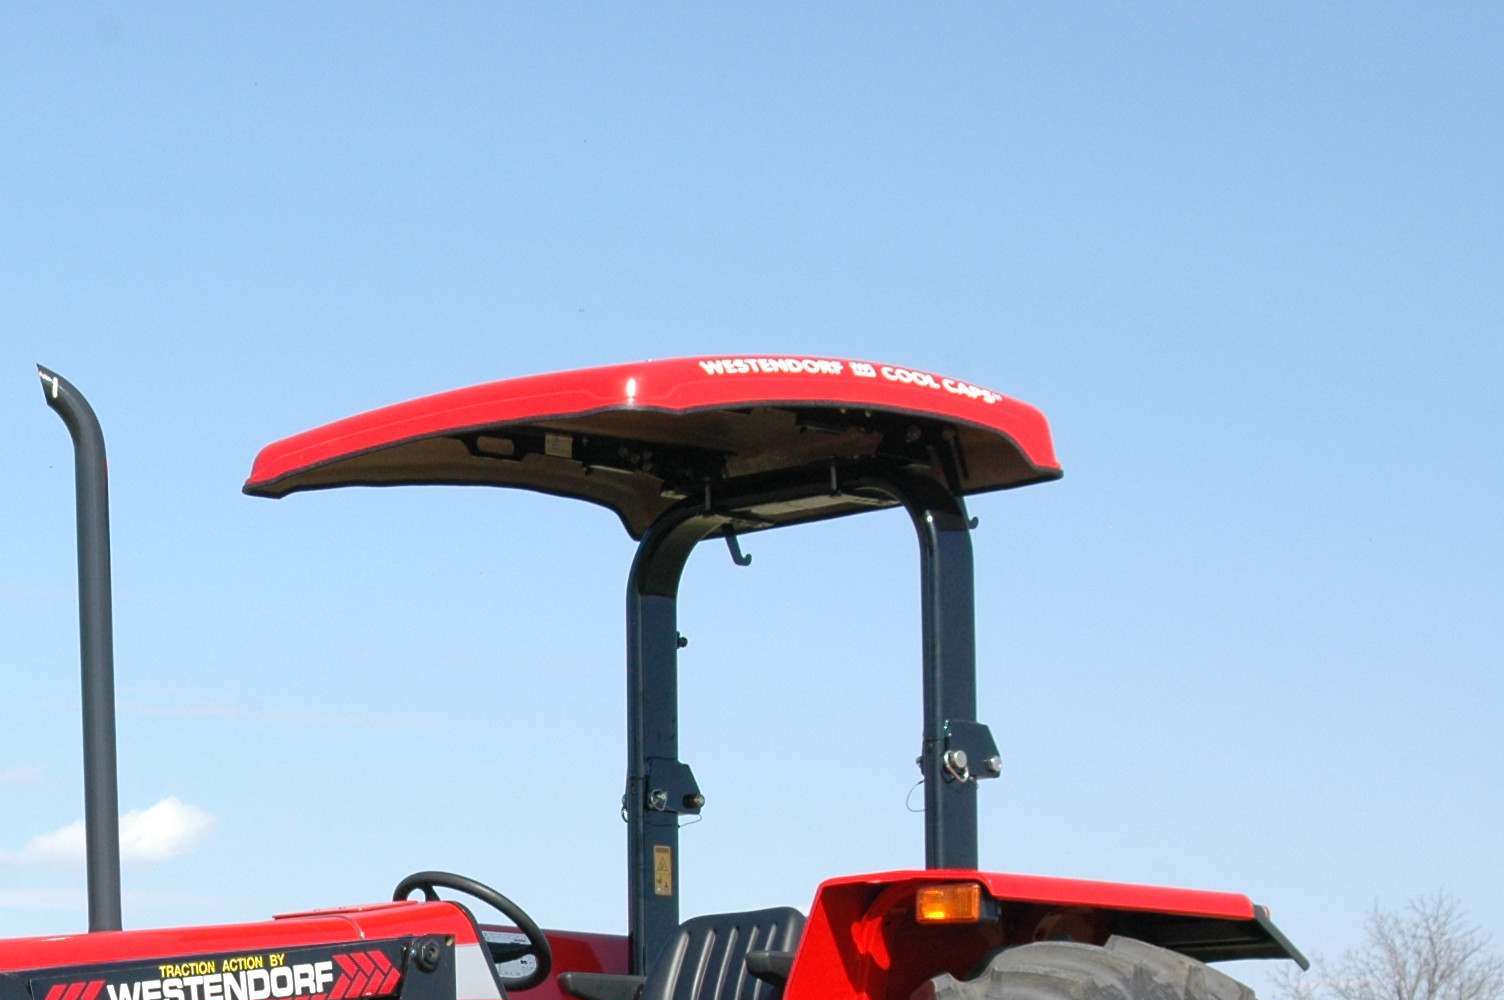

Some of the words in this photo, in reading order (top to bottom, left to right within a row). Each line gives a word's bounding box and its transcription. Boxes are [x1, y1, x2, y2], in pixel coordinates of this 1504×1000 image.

[699, 358, 843, 375] WESTENDORF
[881, 366, 940, 389] COOL
[159, 961, 215, 978] TRACTION
[222, 956, 263, 972] ACTION
[269, 953, 285, 967] BY
